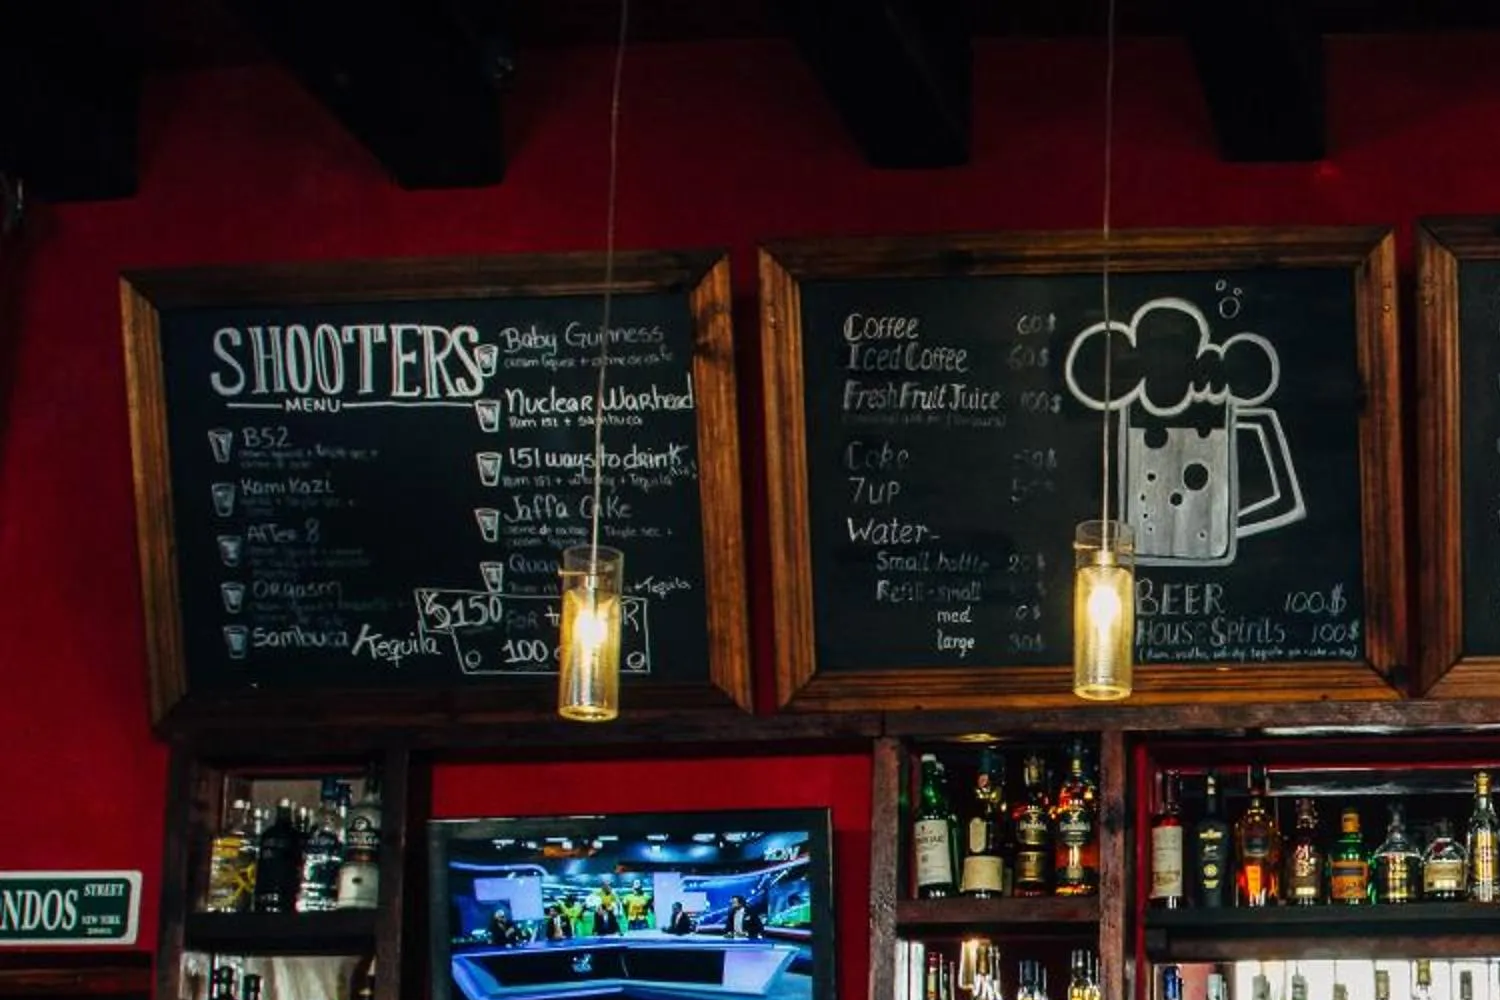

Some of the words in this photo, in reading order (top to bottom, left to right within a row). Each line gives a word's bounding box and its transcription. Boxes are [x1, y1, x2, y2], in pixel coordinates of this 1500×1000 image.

[500, 323, 558, 356] Baby
[842, 312, 921, 342] Coffee
[209, 322, 485, 400] SHOOTERS
[846, 342, 900, 371] Iced
[903, 341, 970, 374] Coffee
[284, 396, 342, 414] MENU
[842, 379, 898, 411] Fresh
[900, 380, 950, 412] Fruit
[949, 382, 1002, 411] Juice
[241, 426, 292, 449] B52
[508, 447, 541, 470] 151
[502, 494, 571, 523] Jaffa
[304, 517, 321, 544] 8
[1135, 576, 1226, 616] BEER
[1282, 581, 1349, 617] 100$
[936, 628, 977, 659] large
[1309, 618, 1362, 644] 100$
[501, 639, 549, 664] 100
